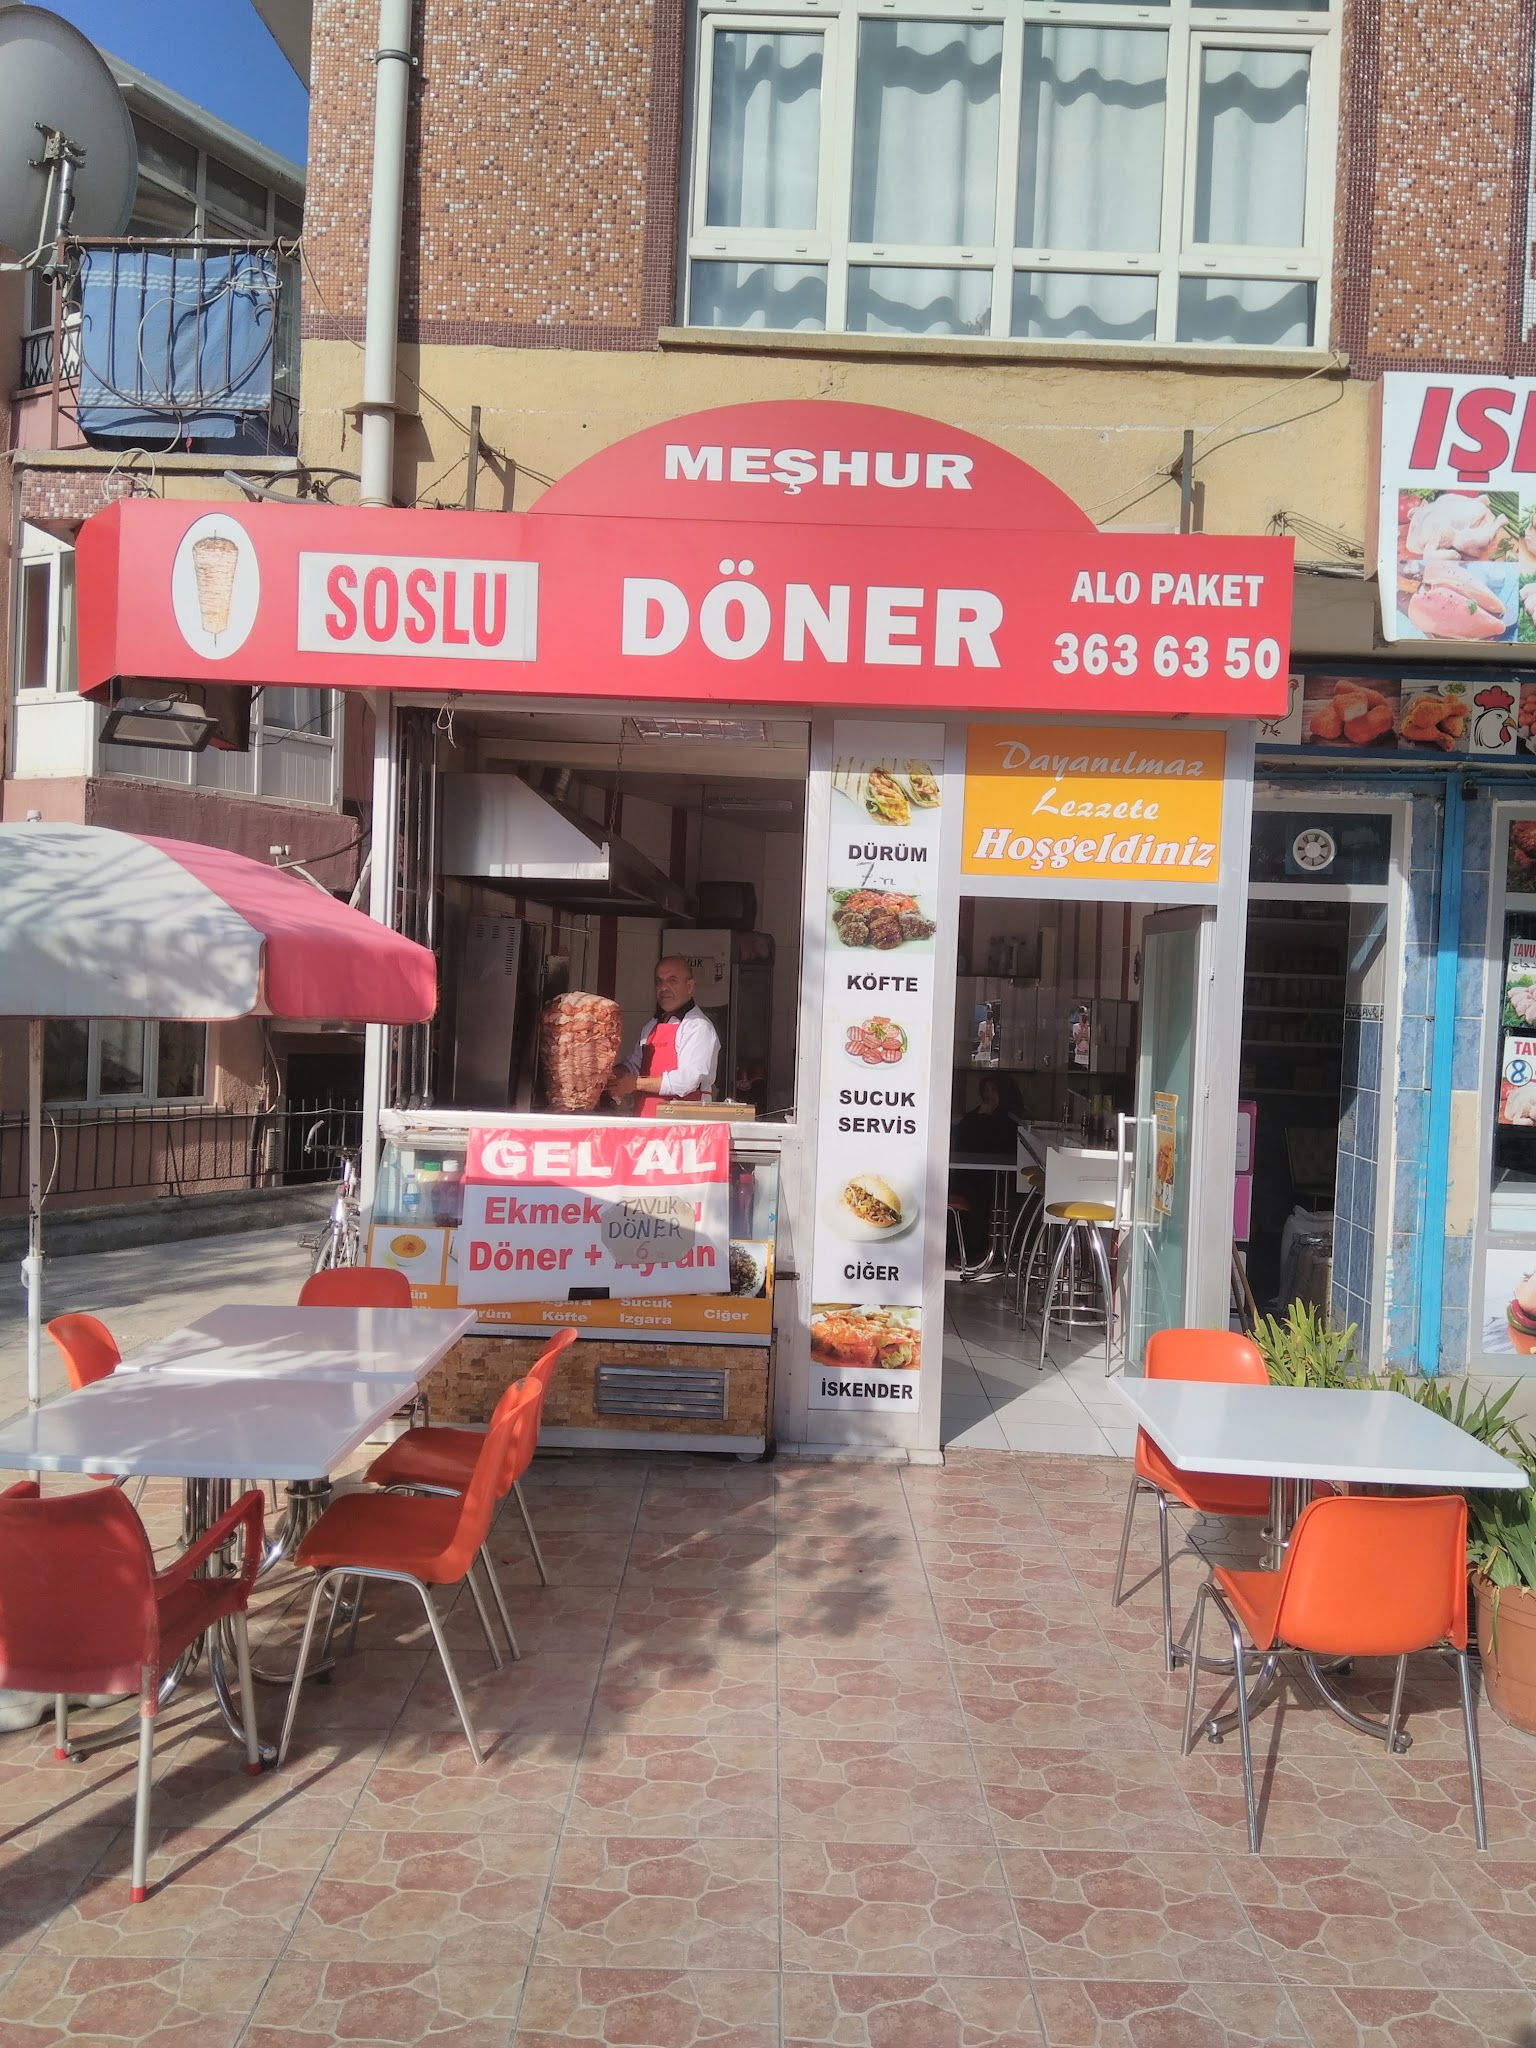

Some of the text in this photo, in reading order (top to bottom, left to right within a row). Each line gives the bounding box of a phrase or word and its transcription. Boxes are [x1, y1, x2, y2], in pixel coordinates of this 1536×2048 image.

[664, 444, 975, 495] MEŞHUR
[1070, 571, 1265, 607] ALO PAKET
[325, 565, 508, 647] SOSLU
[621, 557, 1004, 668] DÖNER
[1052, 632, 1281, 679] 363 63 50
[995, 740, 1205, 782] Dayanılmaz
[1031, 787, 1160, 820] Lezzete
[848, 842, 928, 862] DÜRÜM
[971, 826, 1217, 871] Hoşgeldiniz
[847, 972, 918, 992] KÖFTE
[839, 1089, 916, 1107] SUCUK
[838, 1115, 916, 1134] SERVİS
[481, 1138, 716, 1178] GEL AL
[484, 1196, 603, 1225] Ekmek
[608, 1218, 683, 1240] DÖNER
[469, 1241, 573, 1271] Döner
[844, 1261, 899, 1281] CİĞER
[542, 1311, 588, 1322] Köfte
[620, 1313, 672, 1325] Izgara
[703, 1308, 750, 1321] Ciğer
[821, 1378, 913, 1399] İSKENDER
